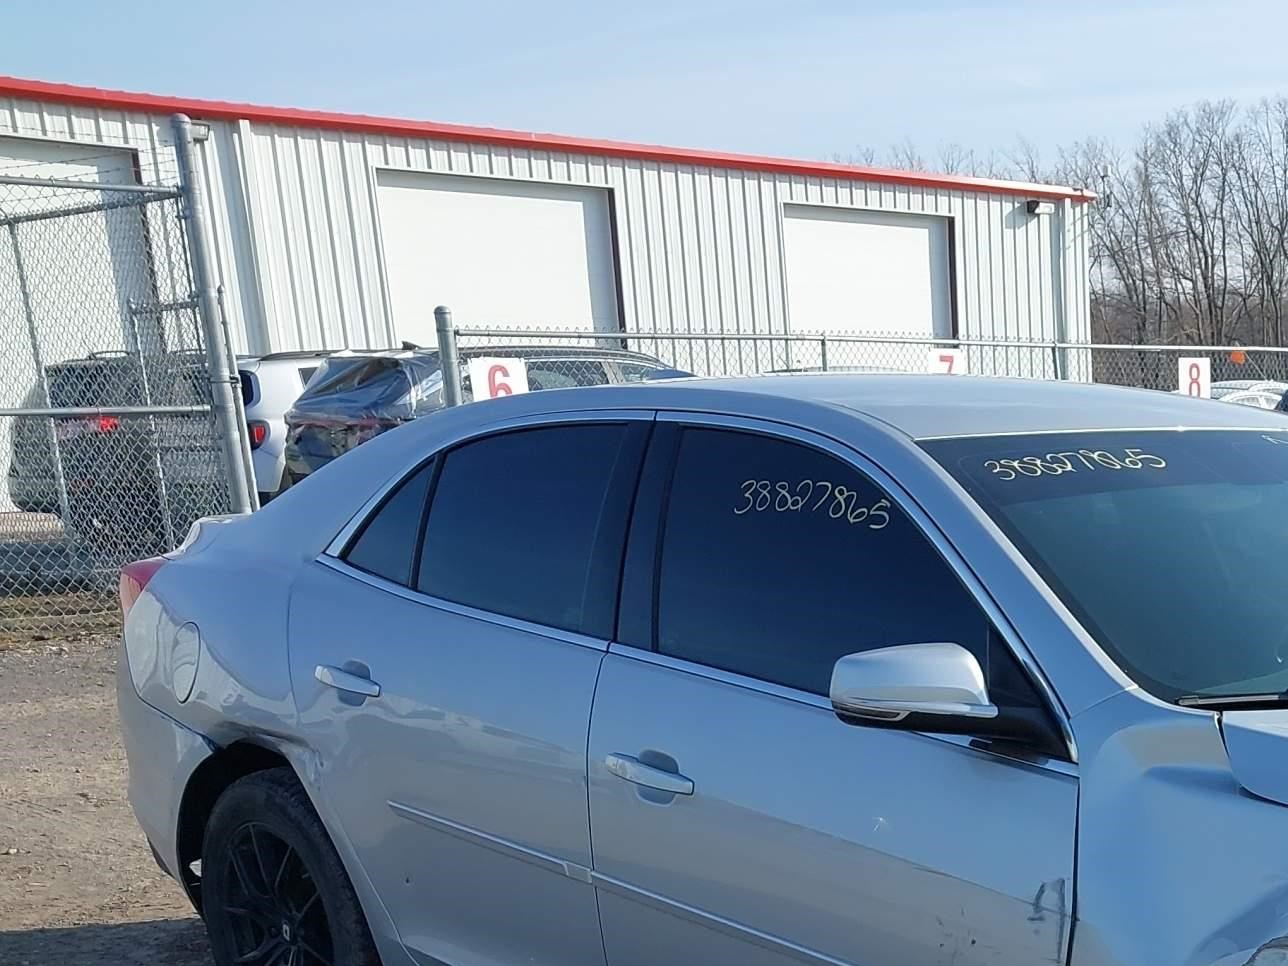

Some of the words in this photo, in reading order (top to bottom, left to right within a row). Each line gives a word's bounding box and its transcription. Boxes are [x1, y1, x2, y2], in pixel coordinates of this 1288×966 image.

[488, 364, 513, 399] 6
[1188, 363, 1201, 397] 8
[983, 448, 1167, 481] 38827865
[734, 479, 891, 529] 38827865
